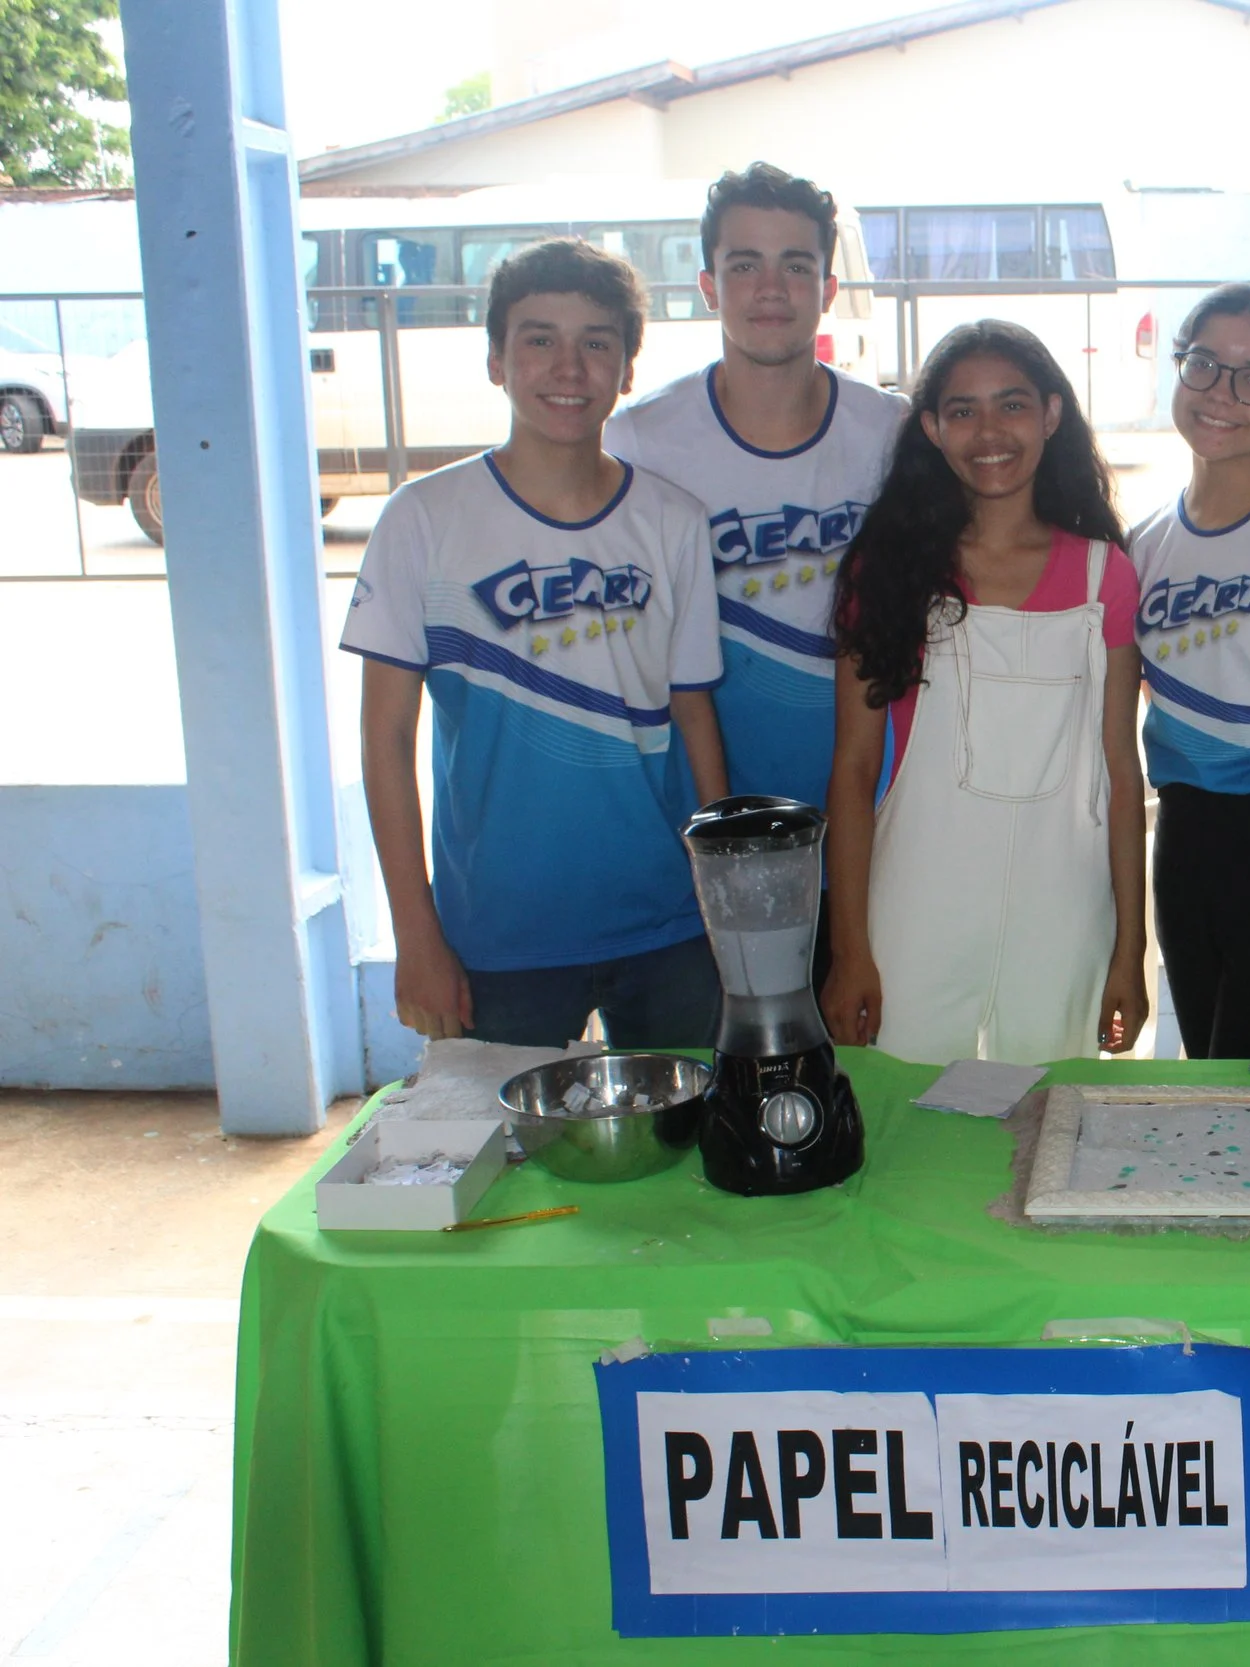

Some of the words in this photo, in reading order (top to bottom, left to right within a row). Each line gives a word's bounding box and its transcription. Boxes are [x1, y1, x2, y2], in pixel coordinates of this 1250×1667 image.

[478, 559, 653, 628] CEART
[664, 1429, 934, 1540] PAPEL
[959, 1420, 1229, 1529] RECICLÁVEL
